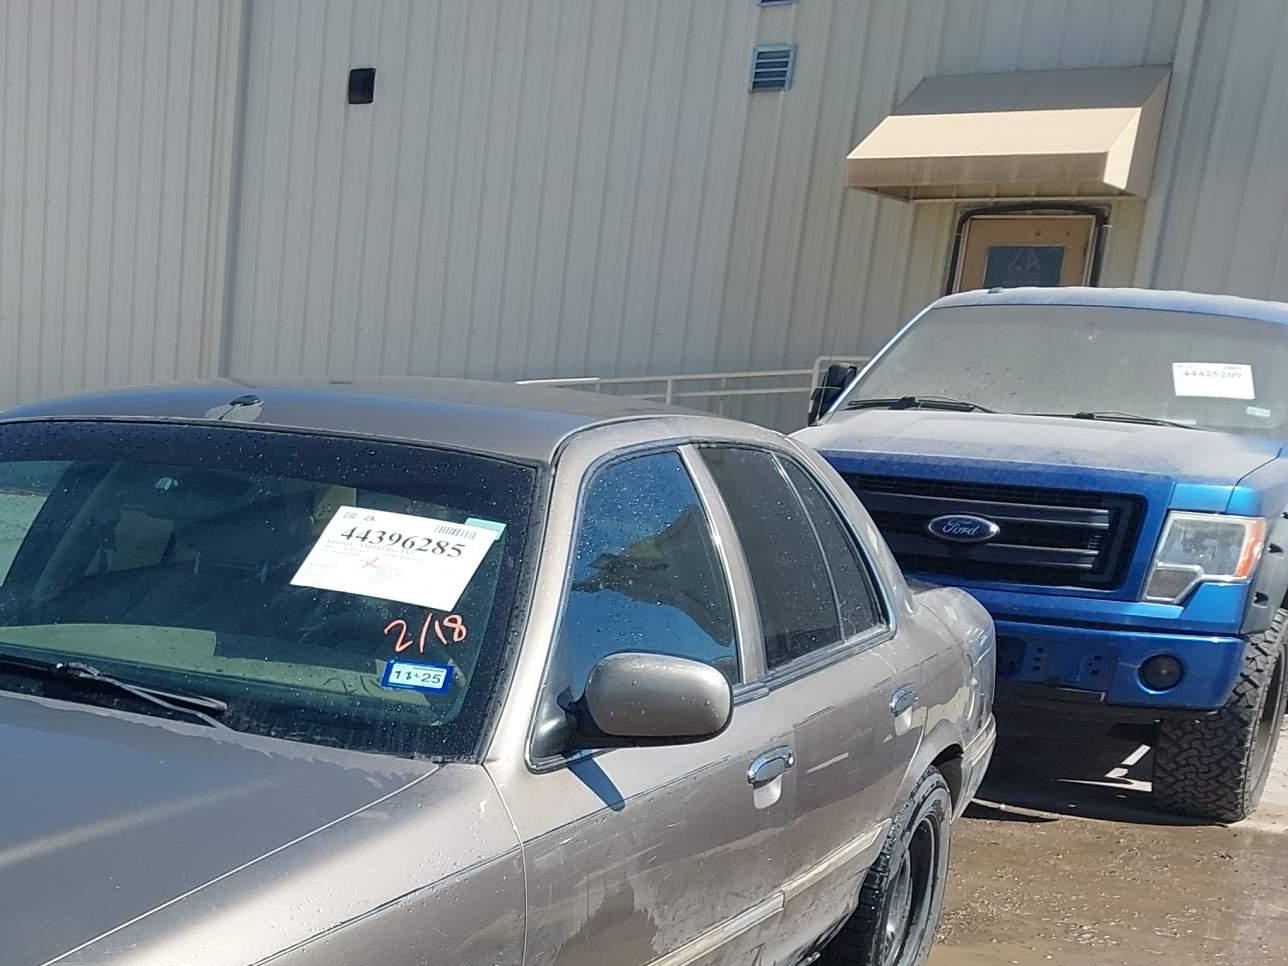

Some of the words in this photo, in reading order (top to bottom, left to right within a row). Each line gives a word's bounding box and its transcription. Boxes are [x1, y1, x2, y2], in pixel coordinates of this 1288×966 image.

[340, 525, 466, 558] 44396285
[942, 519, 980, 535] Ford
[383, 612, 467, 653] 2/18
